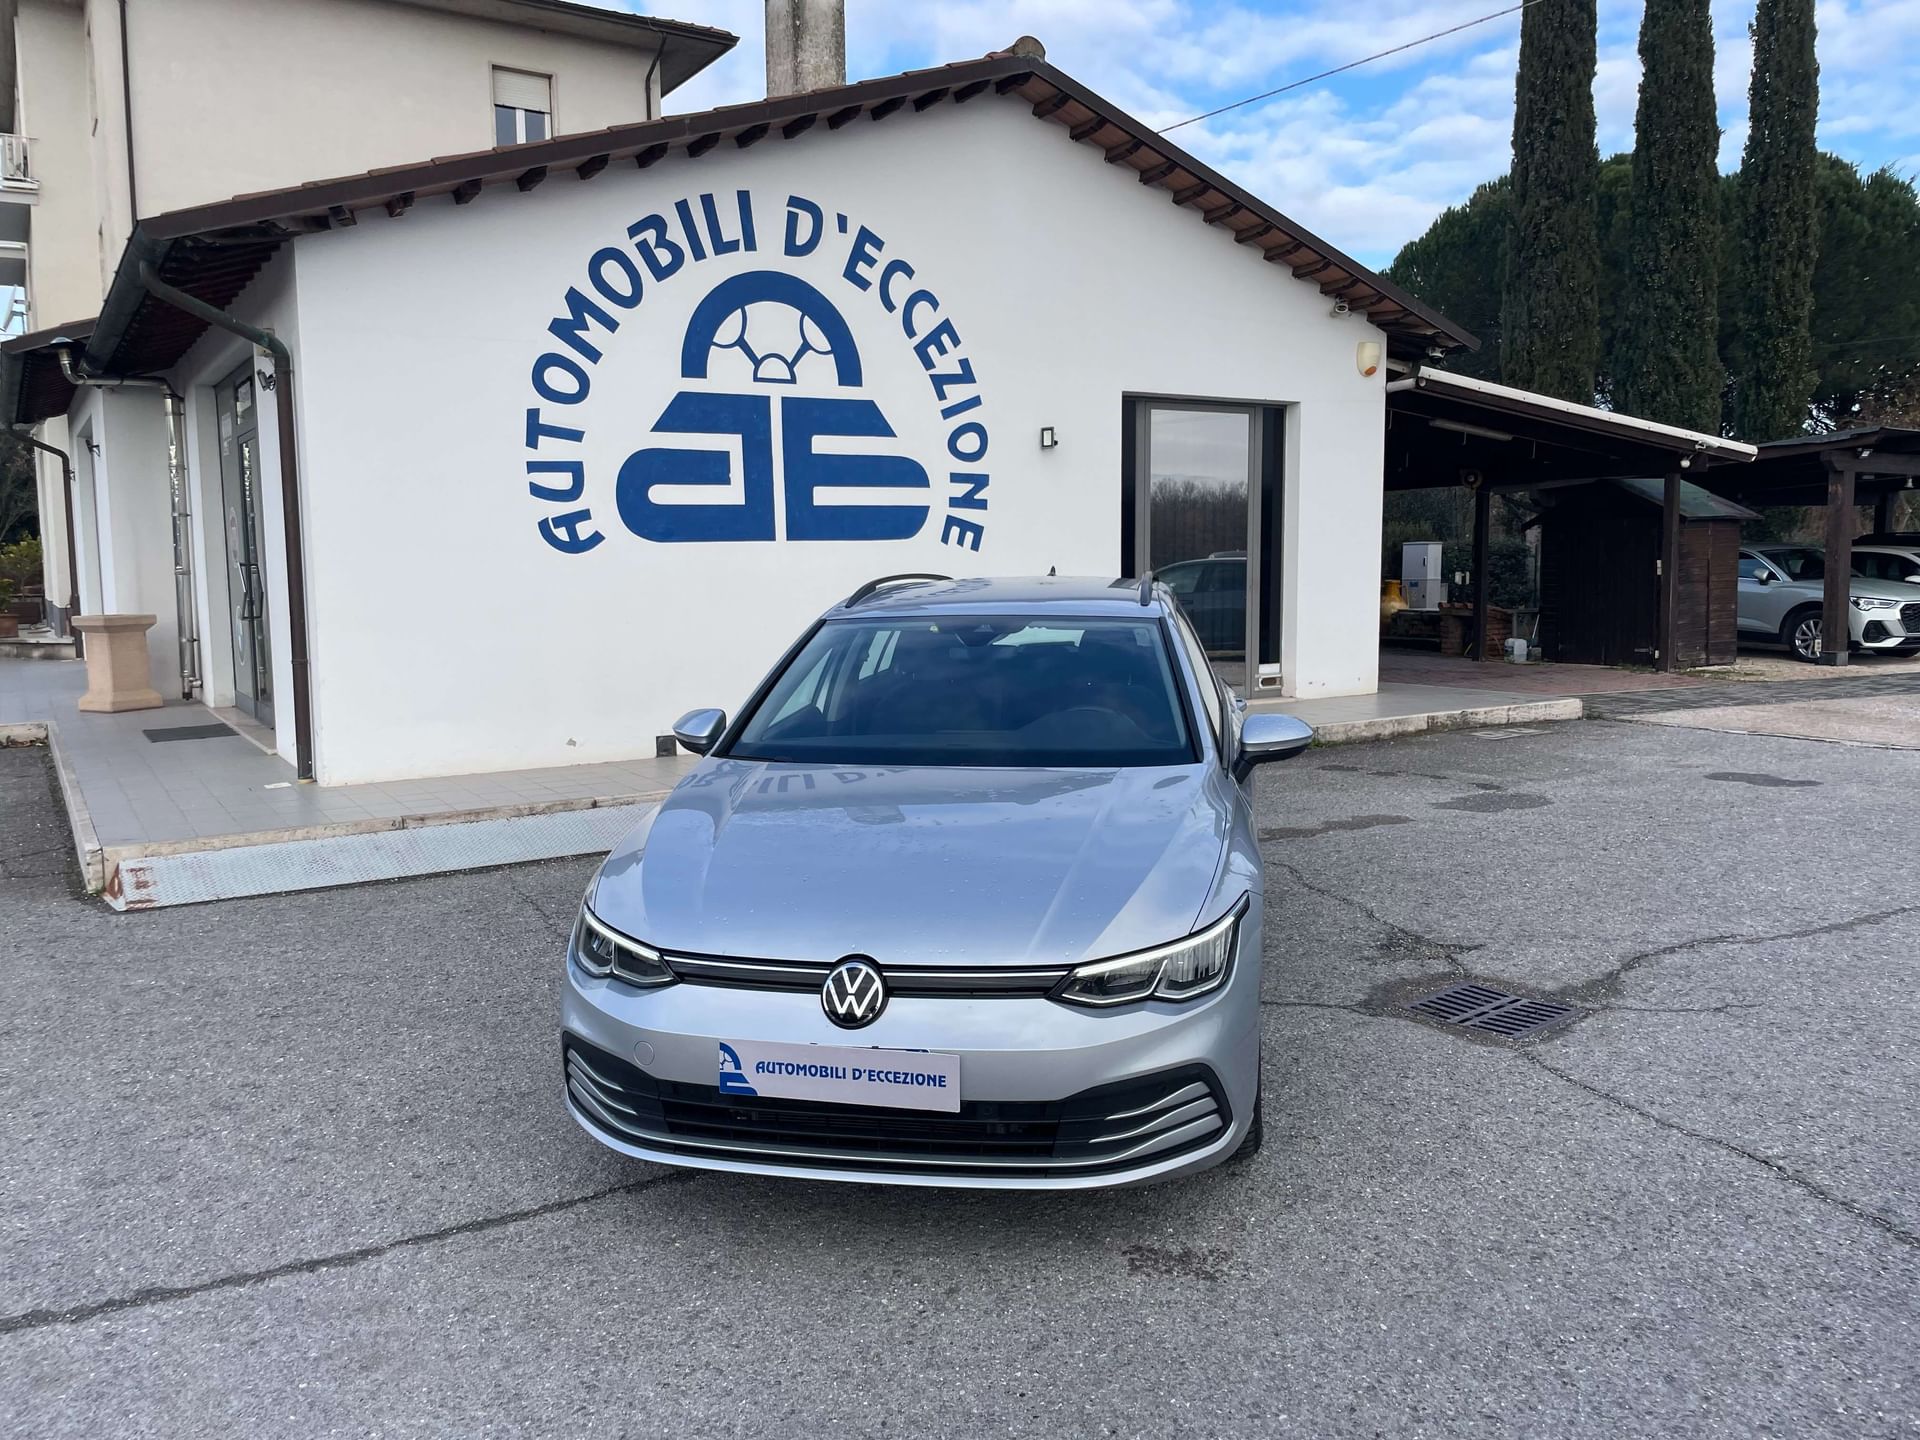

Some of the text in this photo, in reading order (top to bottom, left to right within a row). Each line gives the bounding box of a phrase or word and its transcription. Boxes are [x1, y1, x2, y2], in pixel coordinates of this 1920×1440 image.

[526, 191, 990, 554] AUTOMOBILI D'ECCEZIONE
[825, 962, 884, 1020] VW
[755, 1061, 947, 1088] AUTOMOBILI D'ECCEZIONE
